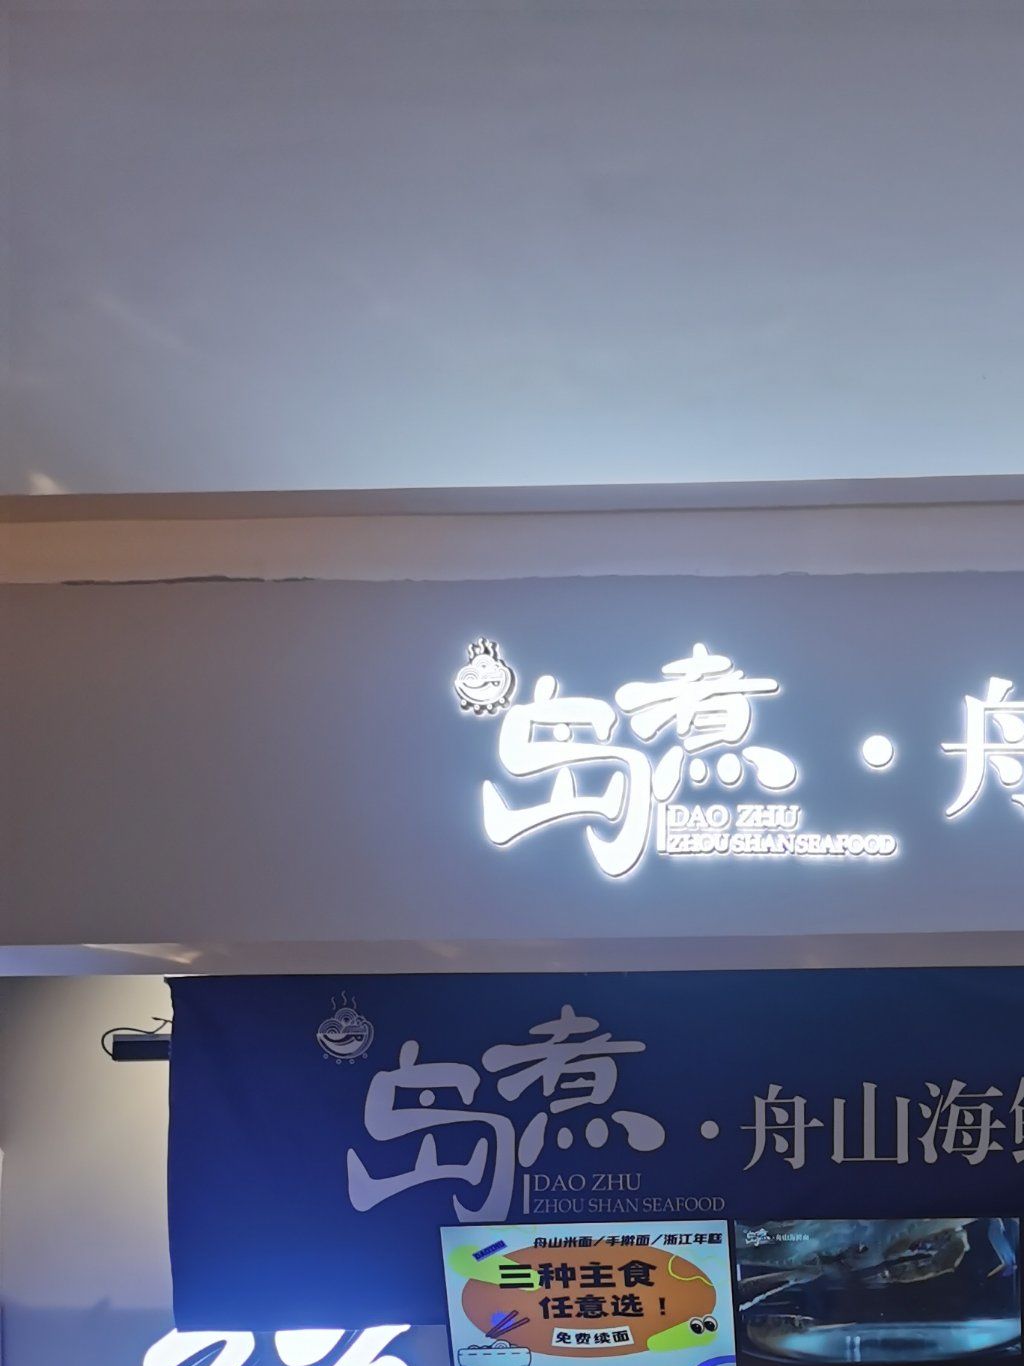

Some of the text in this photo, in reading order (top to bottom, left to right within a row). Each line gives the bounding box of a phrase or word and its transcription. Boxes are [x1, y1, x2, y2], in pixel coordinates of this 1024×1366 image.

[482, 643, 797, 877] 岛煮
[668, 804, 801, 831] DAO ZHU
[668, 833, 898, 856] ZHOU SHAN SEAFOOD
[347, 1004, 665, 1222] 岛煮
[533, 1173, 642, 1192] DAO ZHU
[533, 1195, 726, 1214] ZHOU SHAN SEAFOOD
[499, 1260, 657, 1289] 三种主食
[555, 1329, 631, 1346] 免费续面
